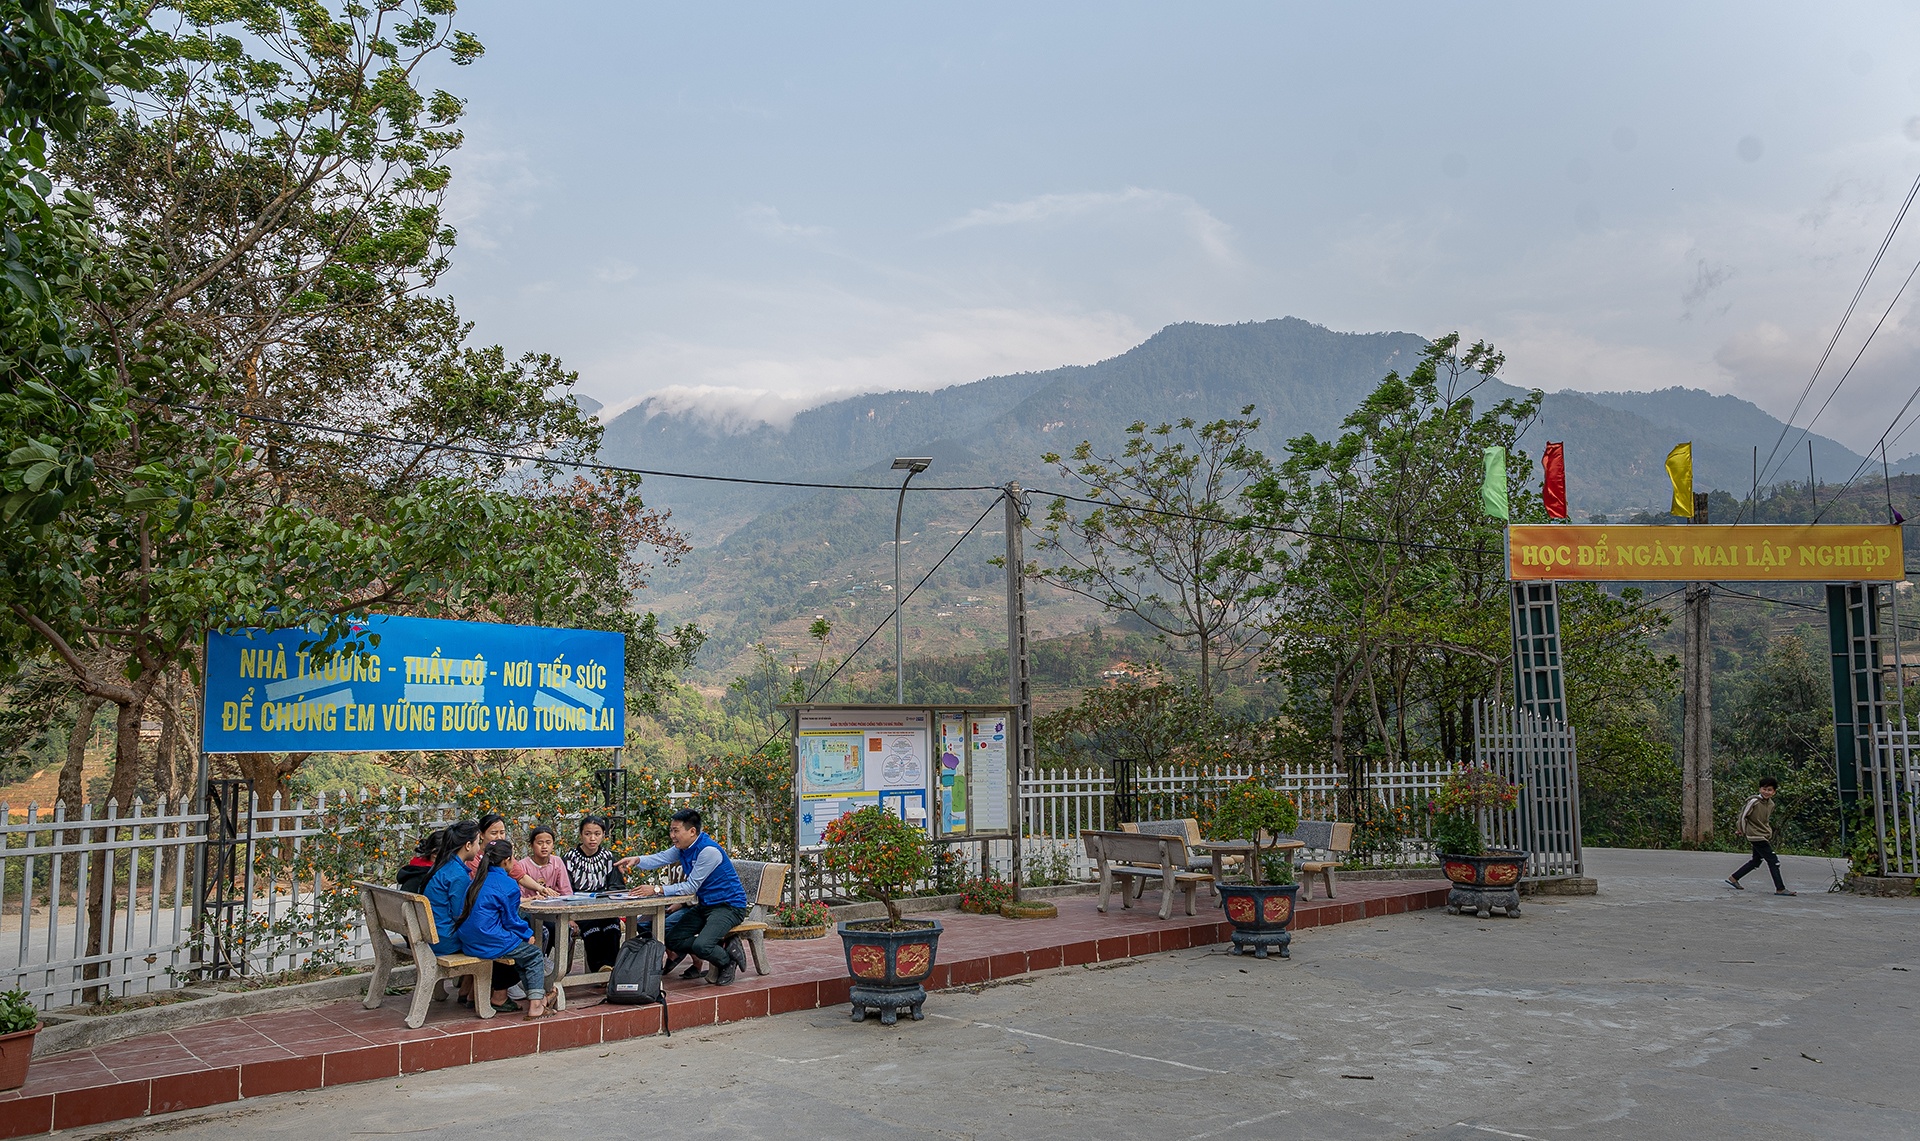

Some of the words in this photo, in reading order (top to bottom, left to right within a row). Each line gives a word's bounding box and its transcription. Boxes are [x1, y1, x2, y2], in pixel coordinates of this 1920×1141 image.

[1521, 545, 1571, 572] HỌC
[1577, 533, 1610, 566] ĐỂ
[1616, 540, 1685, 566] NGÀY
[1692, 545, 1739, 566] MAI
[1744, 539, 1792, 572] LẬP
[1798, 539, 1891, 572] NGHIỆP
[239, 643, 287, 680] NHÀ
[460, 653, 485, 686] CÔ
[503, 660, 533, 688] NƠI
[537, 653, 573, 689] TIẾP
[576, 659, 607, 690] SỨC
[221, 687, 254, 731] ĐỂ
[260, 695, 337, 731] CHÚNG
[344, 703, 375, 731] EM
[382, 697, 435, 731] VỮNG
[441, 700, 490, 732] BƯỚC
[495, 700, 528, 731] VÀO
[534, 705, 586, 732] TƯƠNG
[591, 707, 615, 731] LAI
